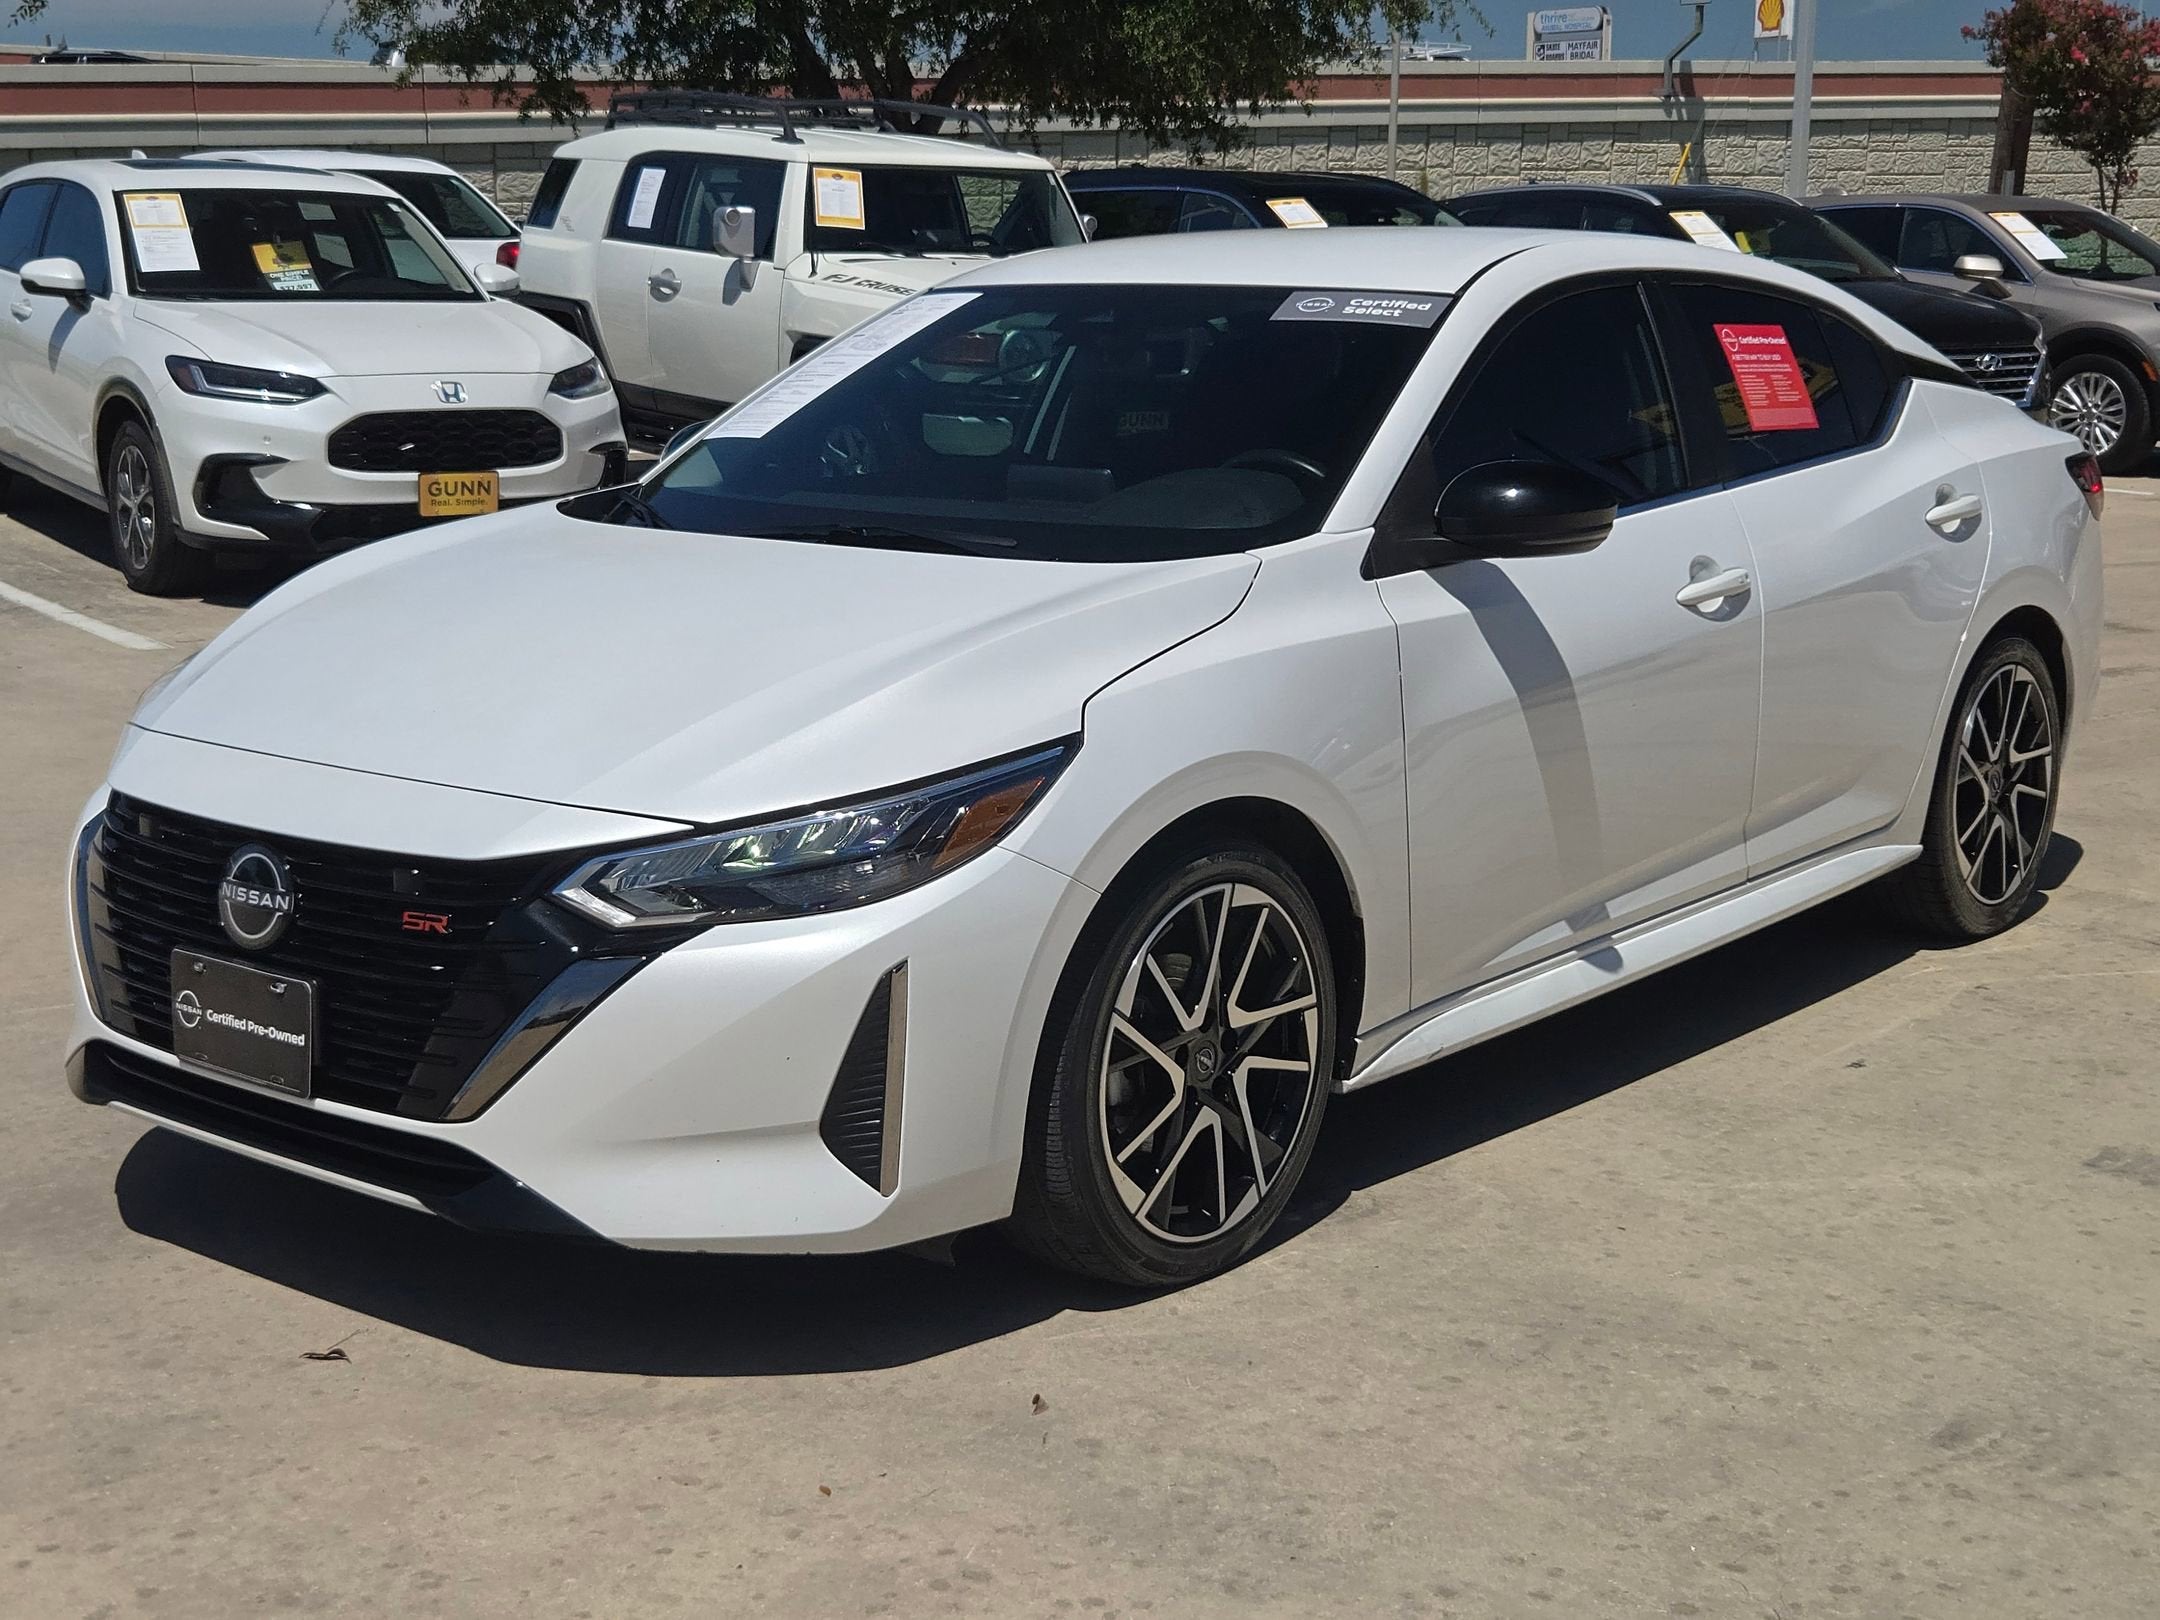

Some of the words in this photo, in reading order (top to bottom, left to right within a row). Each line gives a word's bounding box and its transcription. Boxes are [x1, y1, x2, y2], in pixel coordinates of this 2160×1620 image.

[1541, 14, 1568, 24] thrive
[1567, 41, 1599, 51] MAYFAIR
[1570, 51, 1596, 60] BRIDAL
[823, 273, 860, 283] FJ
[1350, 298, 1433, 311] Certified
[1342, 306, 1403, 317] Select
[427, 480, 492, 497] GUNN
[431, 498, 453, 507] Real.
[455, 497, 489, 507] Simple.
[221, 881, 291, 910] NISSAN
[402, 911, 450, 934] SR
[175, 1001, 203, 1016] NISSAN
[206, 1009, 248, 1031] Certified
[247, 1020, 305, 1046] Pre-Owned
